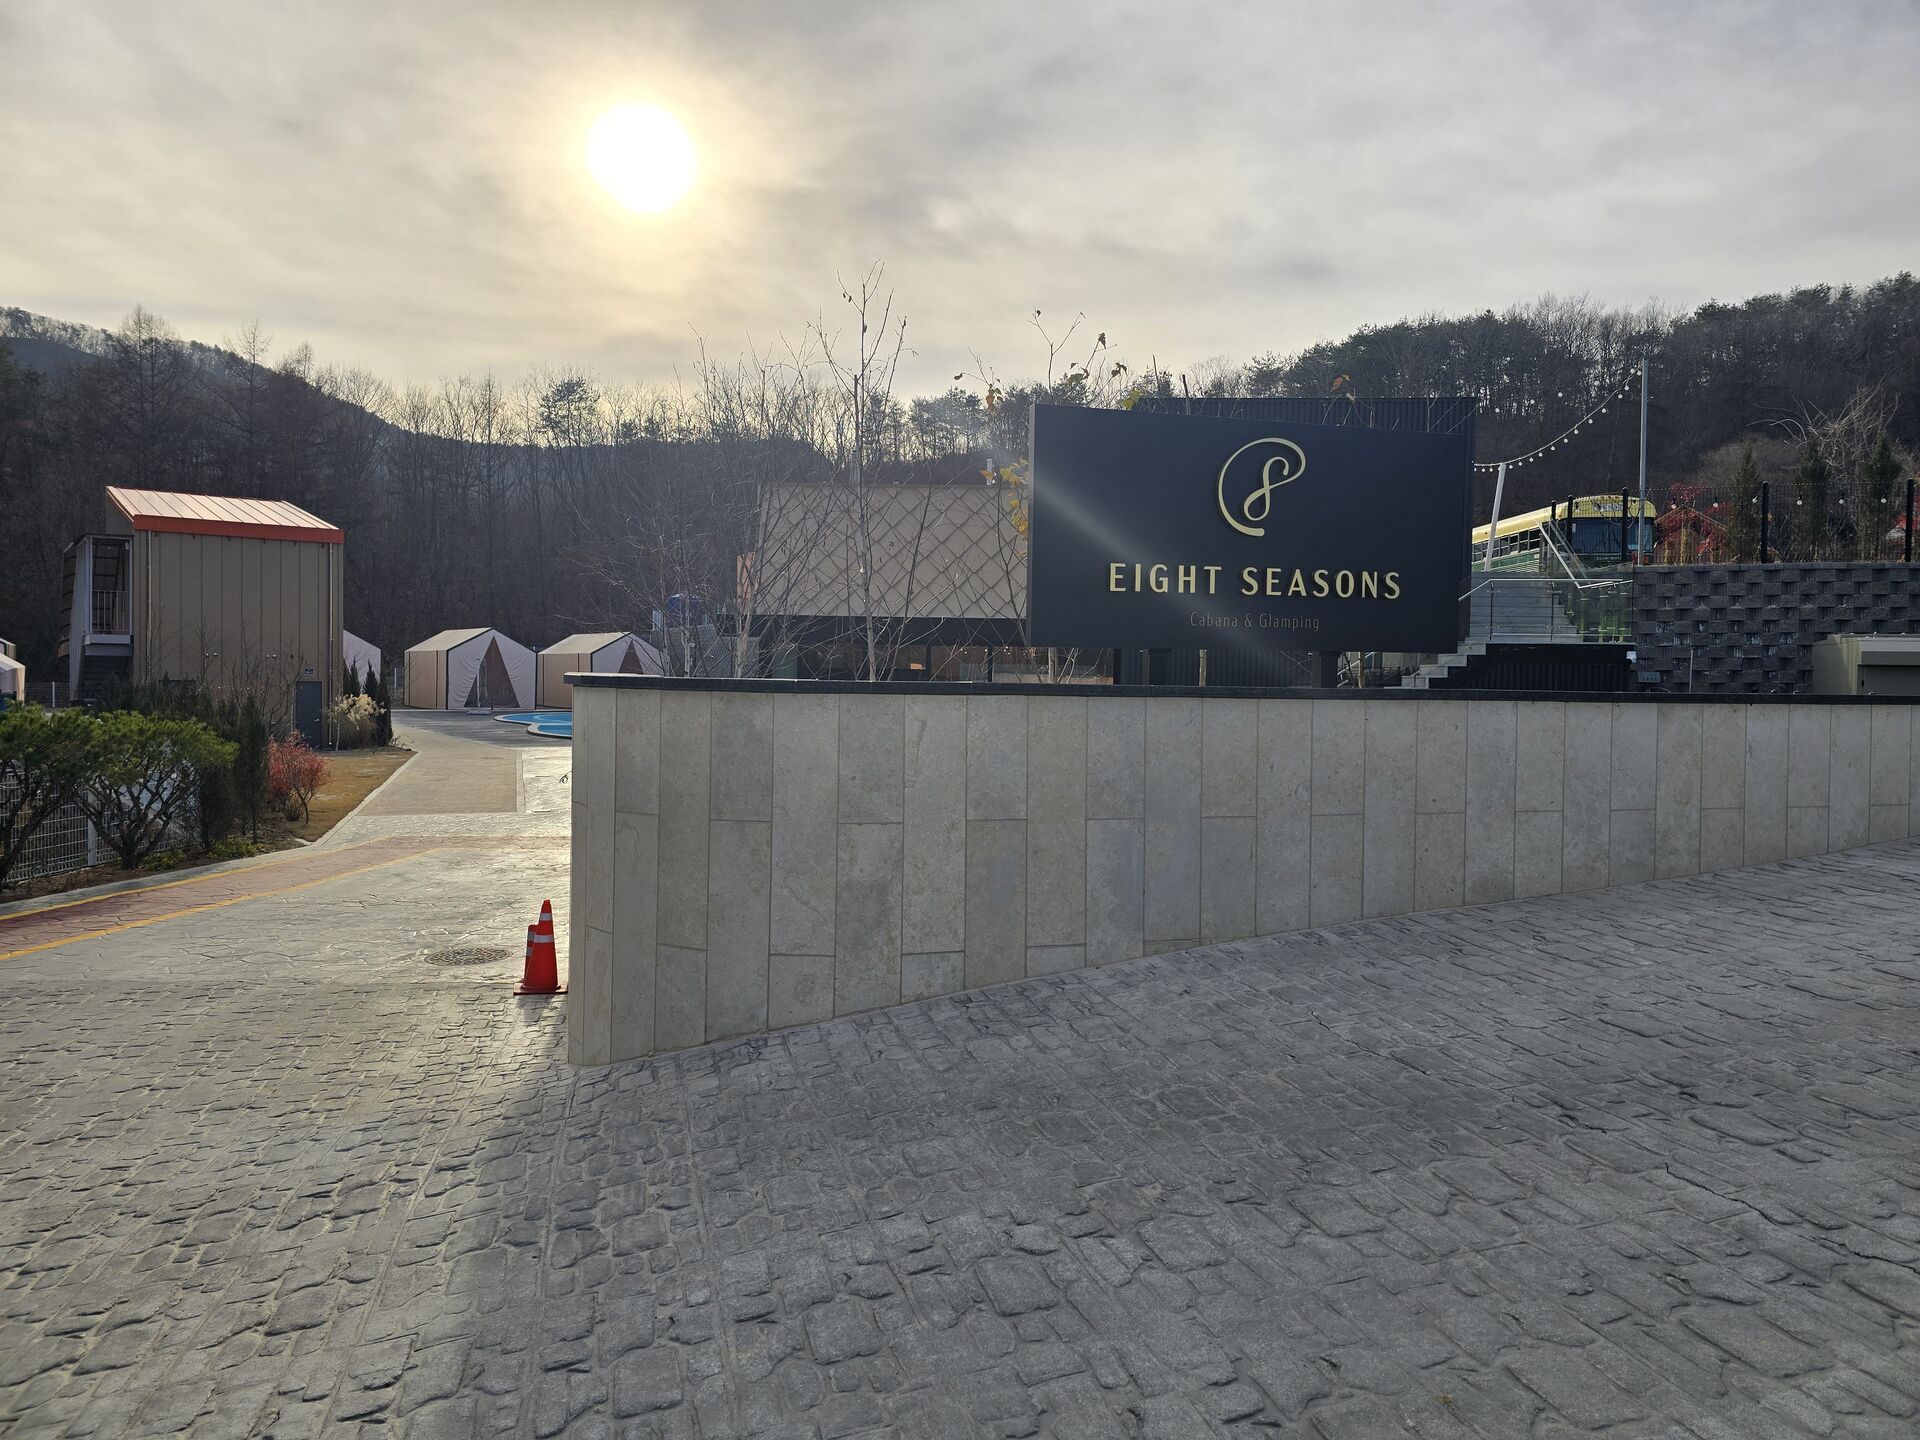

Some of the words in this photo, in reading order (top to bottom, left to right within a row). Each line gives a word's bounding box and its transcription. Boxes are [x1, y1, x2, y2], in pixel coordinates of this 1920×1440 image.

[1109, 562, 1222, 594] EIGHT
[1240, 566, 1401, 600] SEASONS
[1190, 611, 1238, 628] Cabana
[1244, 613, 1253, 628] &
[1258, 613, 1319, 632] Glamping
